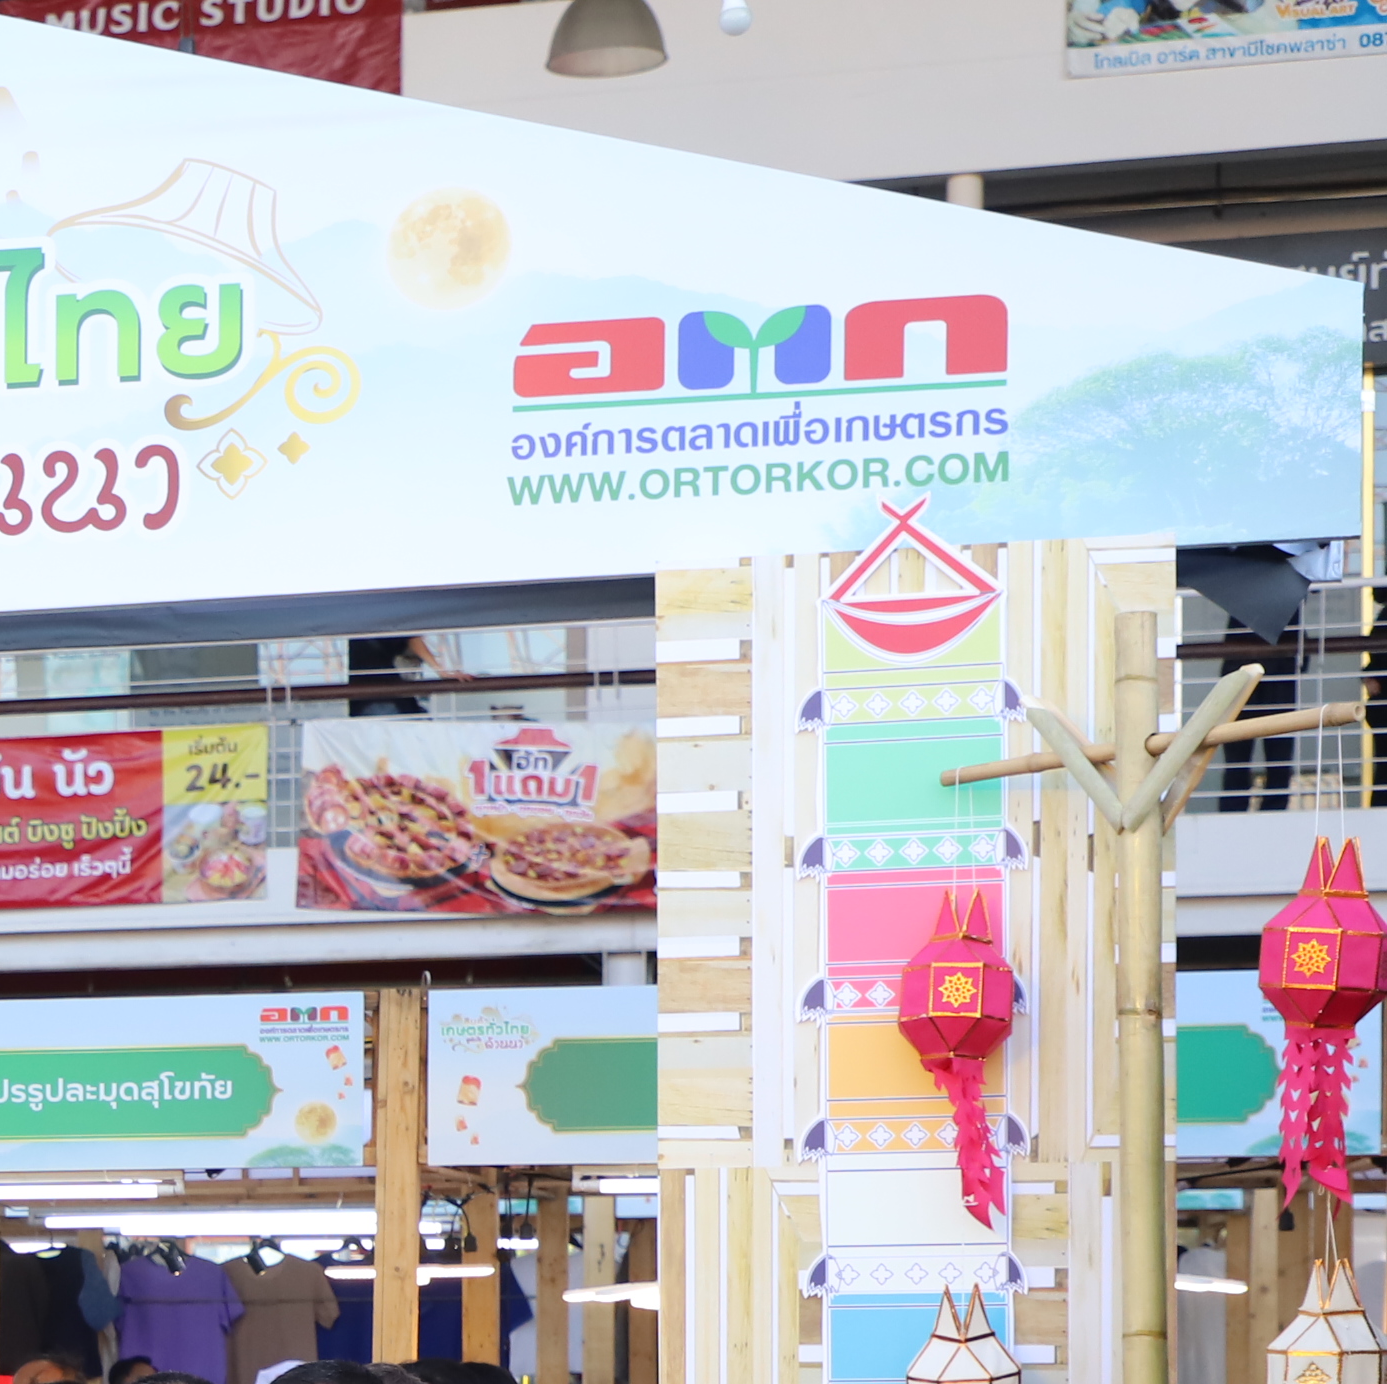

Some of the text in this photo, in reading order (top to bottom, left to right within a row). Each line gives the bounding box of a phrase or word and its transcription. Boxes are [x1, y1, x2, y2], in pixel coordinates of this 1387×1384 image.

[1359, 33, 1387, 49] 08
[510, 402, 1009, 463] องค์การตลาดเพื่อเกษตรกร
[507, 451, 1011, 506] WWW.ORTORKOR.COM
[53, 747, 115, 797] นัว
